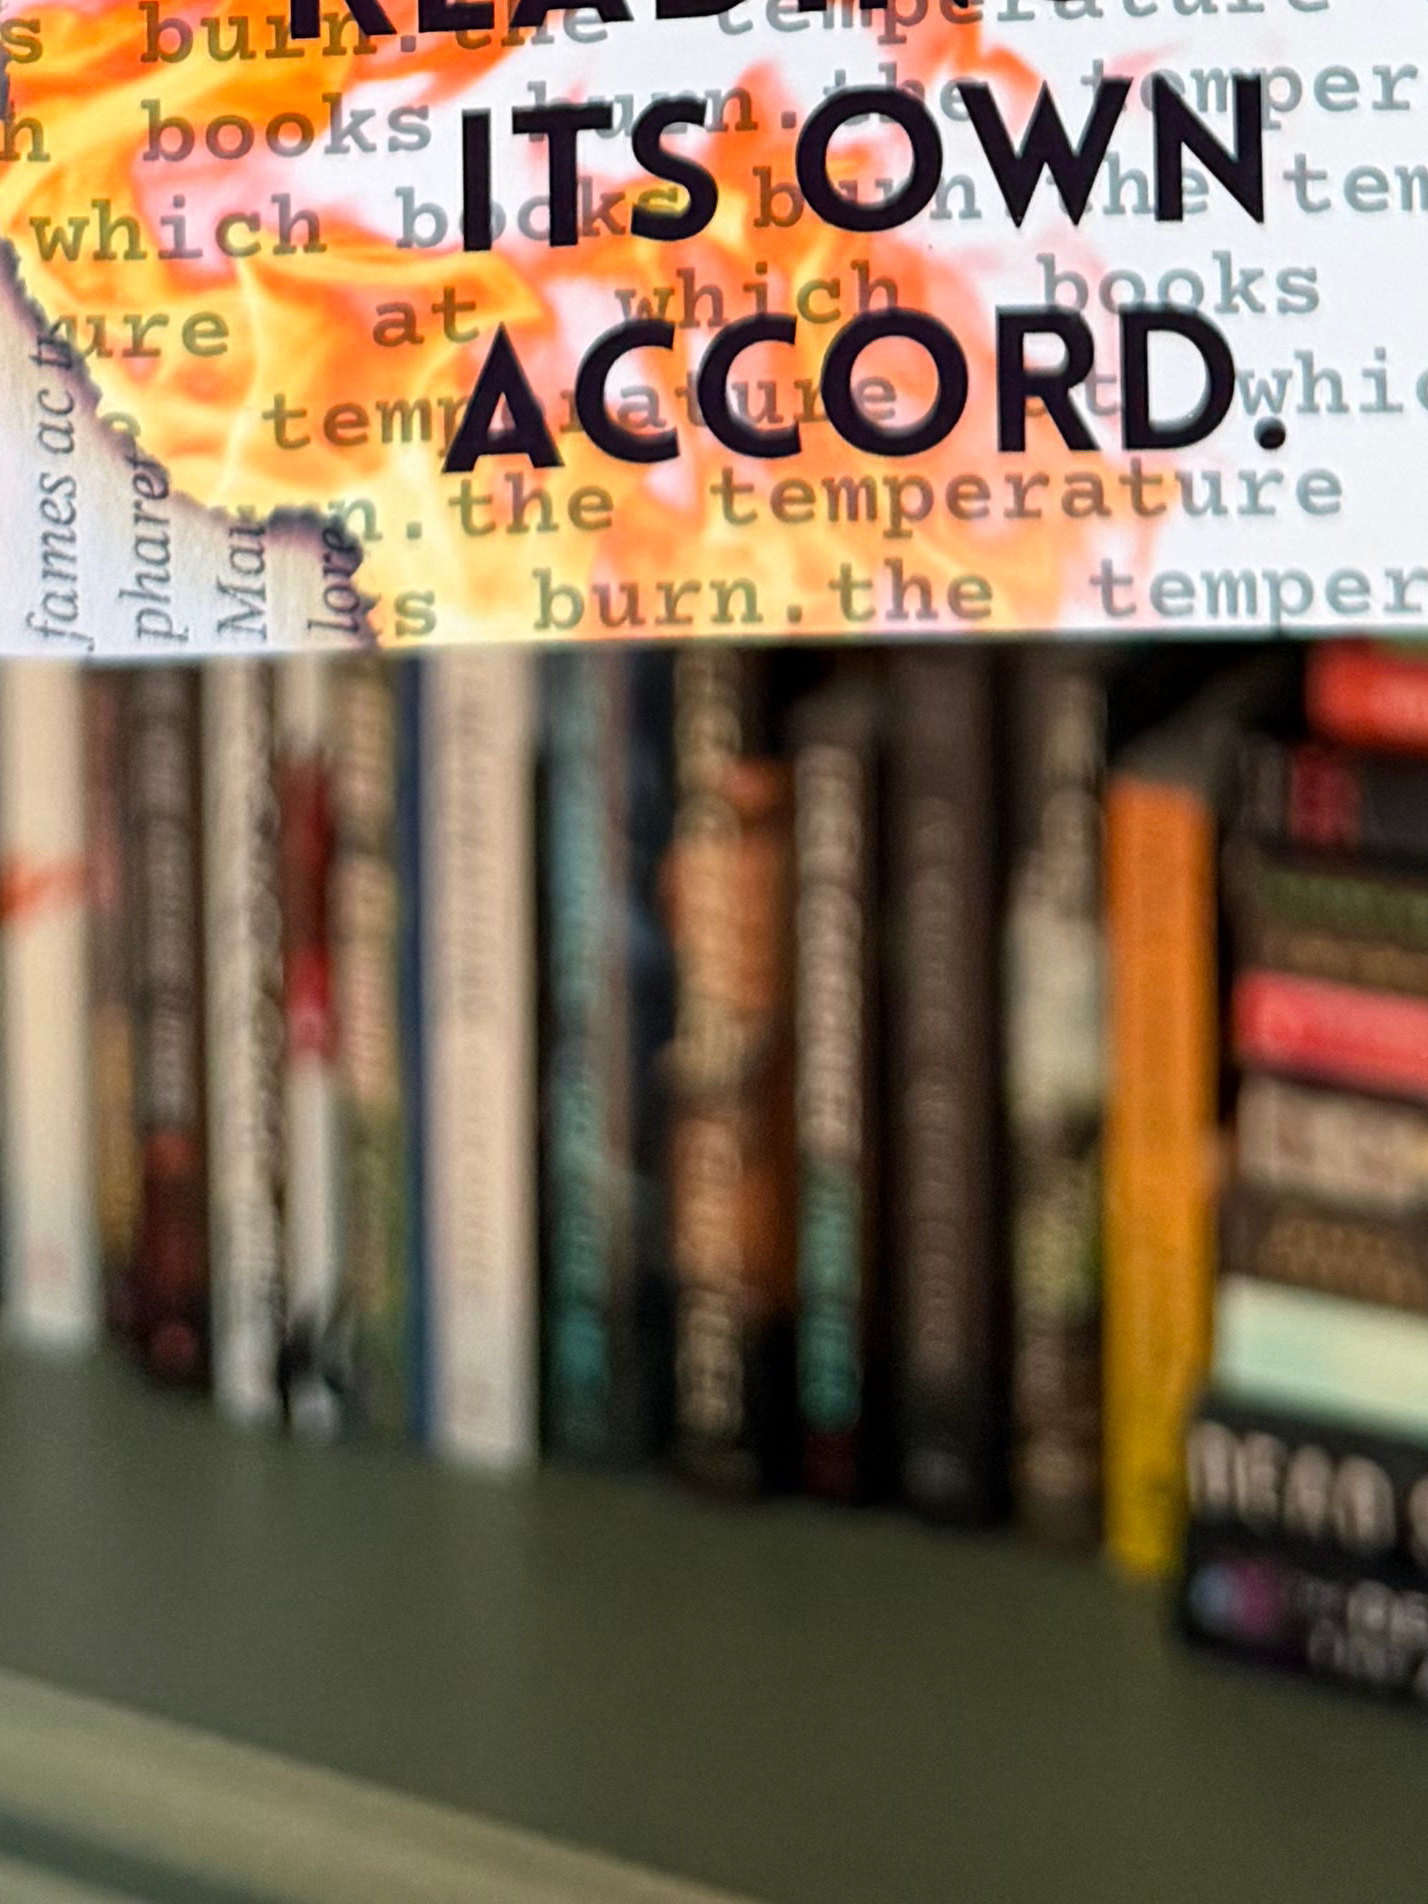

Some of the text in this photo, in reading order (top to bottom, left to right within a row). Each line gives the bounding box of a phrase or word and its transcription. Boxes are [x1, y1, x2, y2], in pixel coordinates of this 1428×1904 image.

[142, 94, 433, 164] books
[461, 97, 719, 252] ITS
[795, 70, 1265, 233] OWN
[28, 192, 327, 263] which
[371, 285, 481, 350] at
[37, 387, 76, 458] ac
[443, 299, 1287, 473] ACCORD.
[709, 451, 1344, 541] temperature
[26, 470, 94, 652] fames
[532, 557, 993, 632] burn.the
